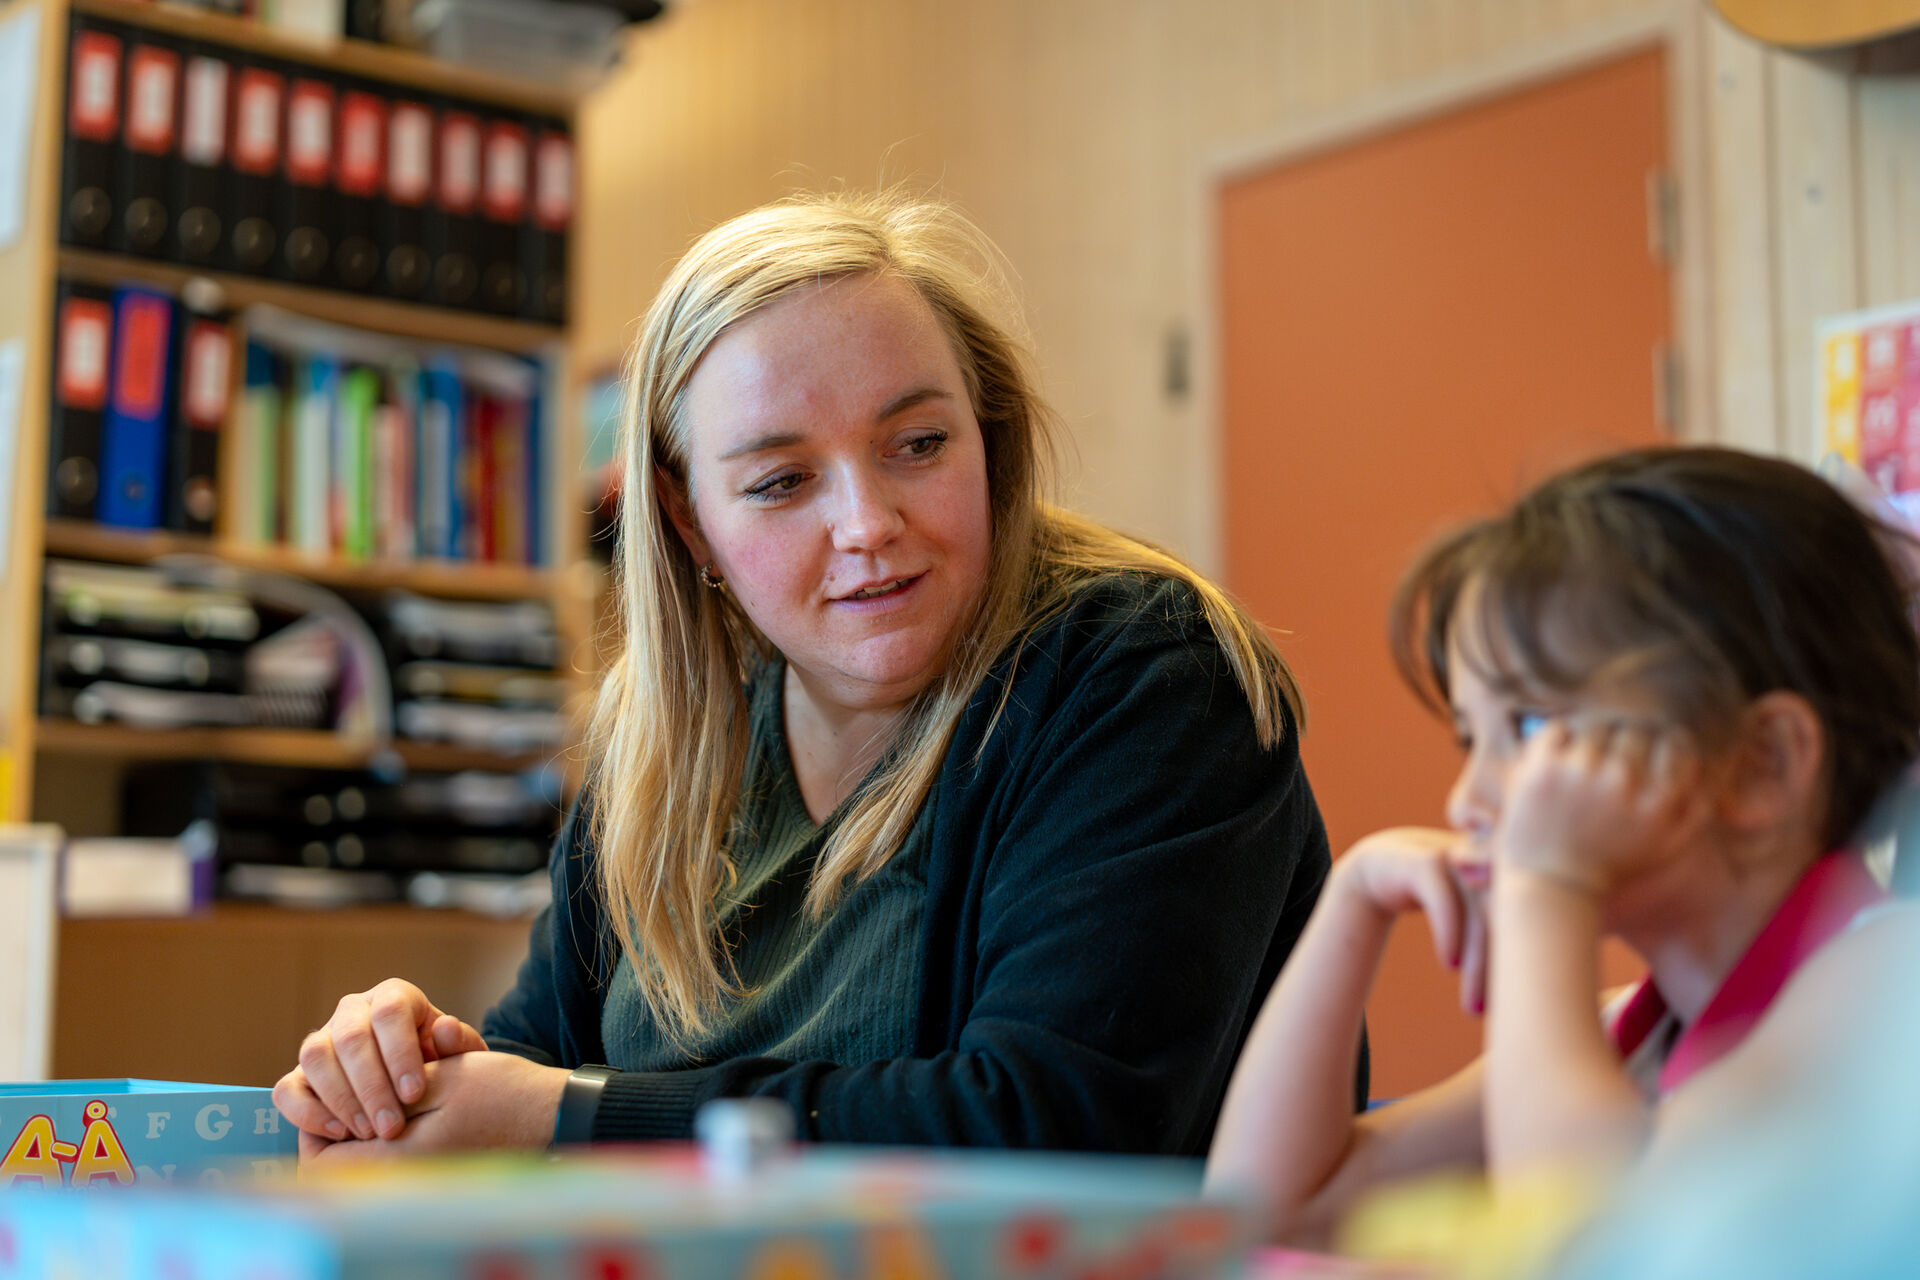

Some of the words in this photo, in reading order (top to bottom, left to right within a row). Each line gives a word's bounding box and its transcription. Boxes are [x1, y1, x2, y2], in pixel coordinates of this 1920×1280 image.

[0, 1100, 136, 1188] A-Å
[145, 1112, 171, 1139] F
[194, 1104, 233, 1141] G
[253, 1108, 280, 1134] H
